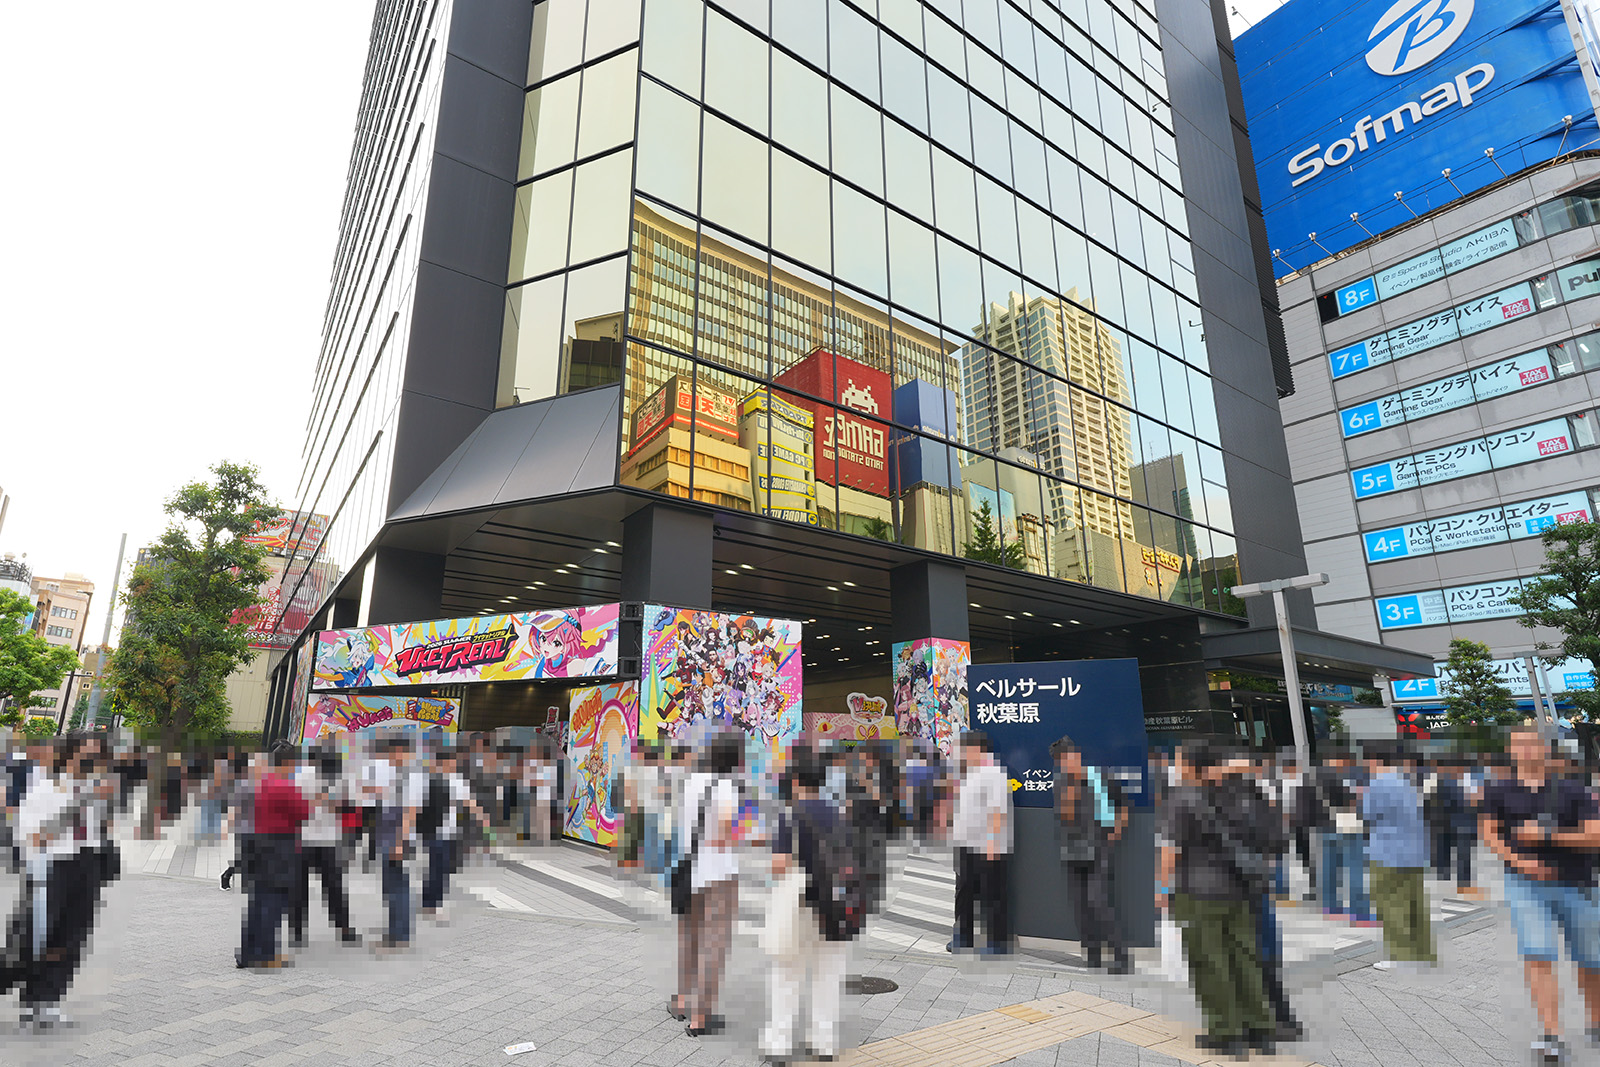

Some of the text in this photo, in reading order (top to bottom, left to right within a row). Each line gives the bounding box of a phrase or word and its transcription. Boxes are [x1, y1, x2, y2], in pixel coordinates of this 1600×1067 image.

[1288, 63, 1495, 188] Sofmap
[1466, 227, 1509, 249] AKIBA
[1344, 289, 1370, 306] 8F
[1506, 300, 1524, 310] TAX
[1504, 305, 1530, 318] FREE
[1369, 296, 1504, 350] ゲーミングデバイス
[1406, 334, 1430, 348] Gear
[1336, 354, 1363, 371] 7F
[1522, 373, 1547, 385] FREE
[1524, 369, 1542, 378] TAX
[1382, 361, 1520, 410] ゲーミングデバイス
[1420, 396, 1444, 409] Gear
[1349, 412, 1375, 428] 6F
[1395, 430, 1536, 473] ゲーミングパソコン
[1540, 443, 1567, 454] FREE
[1541, 438, 1561, 448] TAX
[1435, 462, 1456, 473] PCs
[1361, 473, 1387, 490] 5F
[1409, 501, 1569, 538] パソコン・クリエイター
[1410, 521, 1522, 547] PCs & Workstations
[1373, 536, 1401, 554] 4F
[1385, 603, 1414, 621] 3F
[1451, 602, 1474, 612] PCs
[1476, 601, 1485, 609] &
[443, 636, 472, 645] SUMMER
[975, 677, 1081, 698] ベルサール
[976, 702, 1041, 724] 秋葉原
[1022, 768, 1052, 779] イベン
